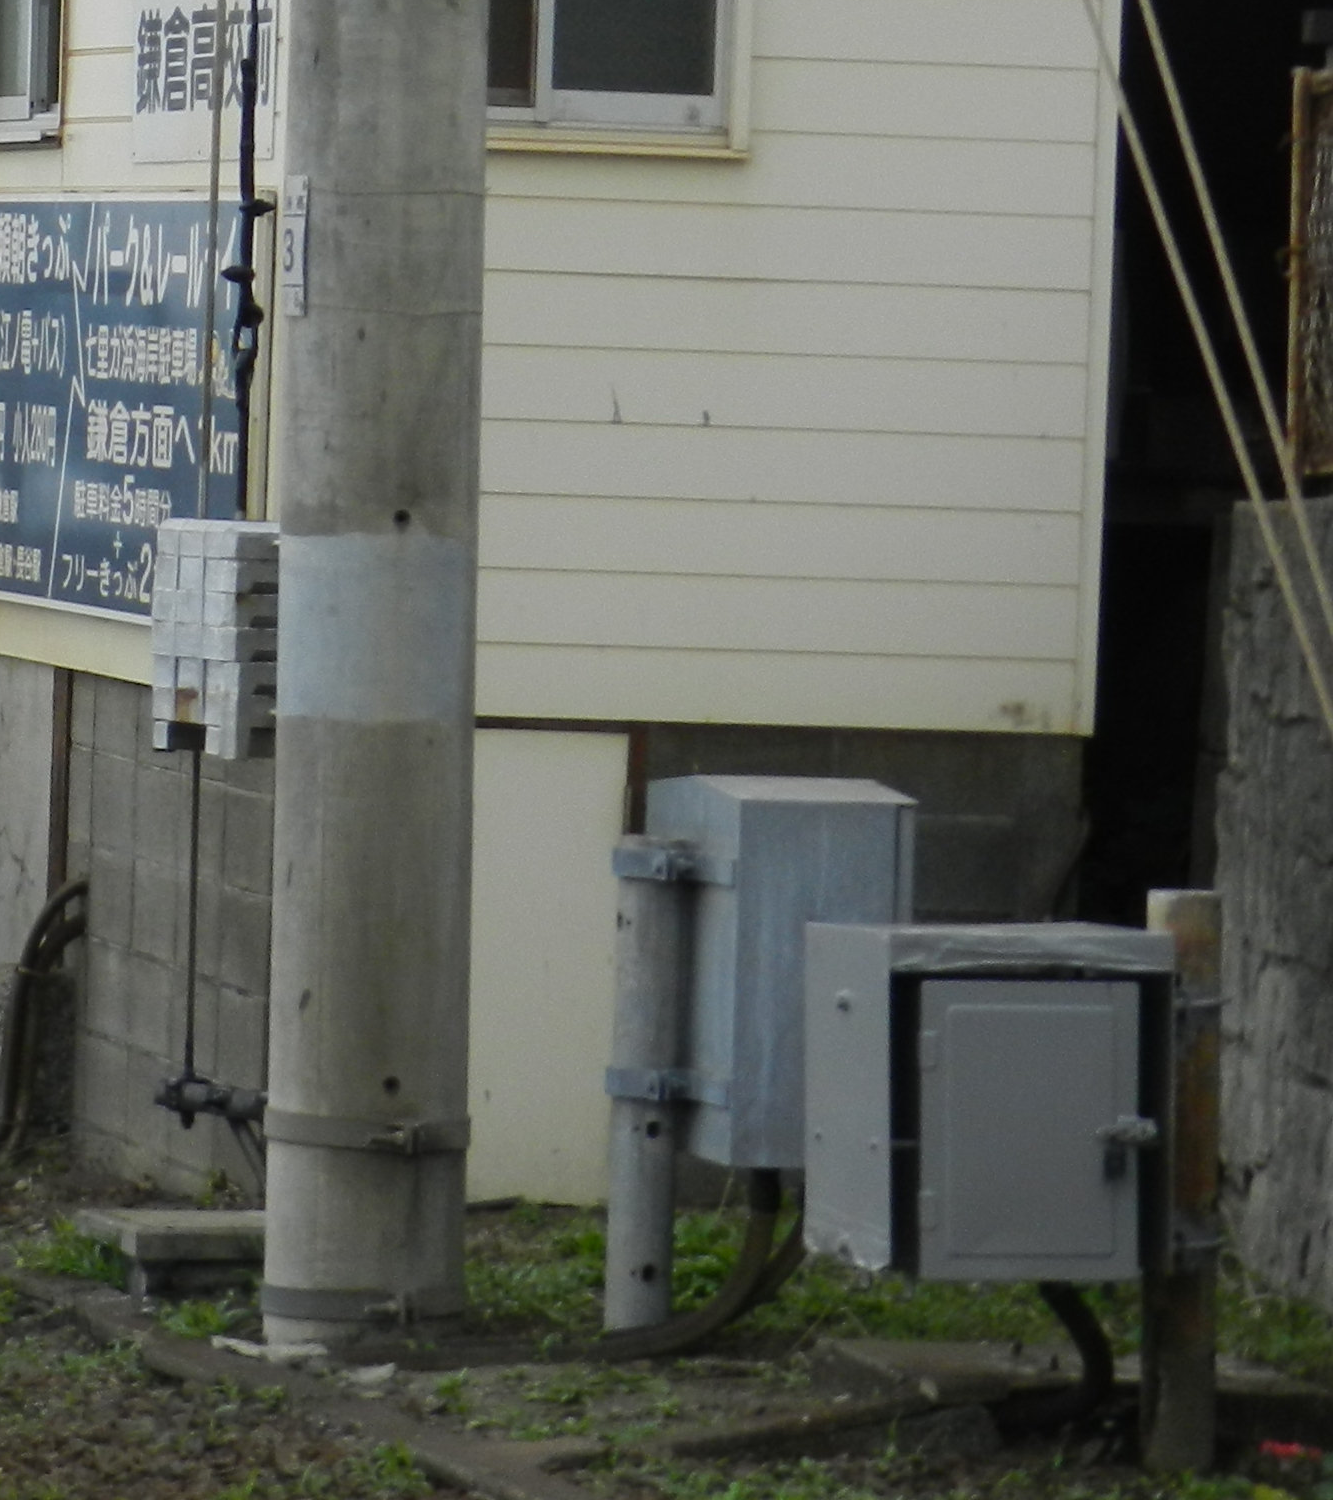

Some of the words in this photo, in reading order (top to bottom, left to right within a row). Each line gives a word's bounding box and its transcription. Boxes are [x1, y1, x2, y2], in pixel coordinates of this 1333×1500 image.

[283, 228, 294, 272] 3
[73, 474, 172, 528] 駐車料金5時間分
